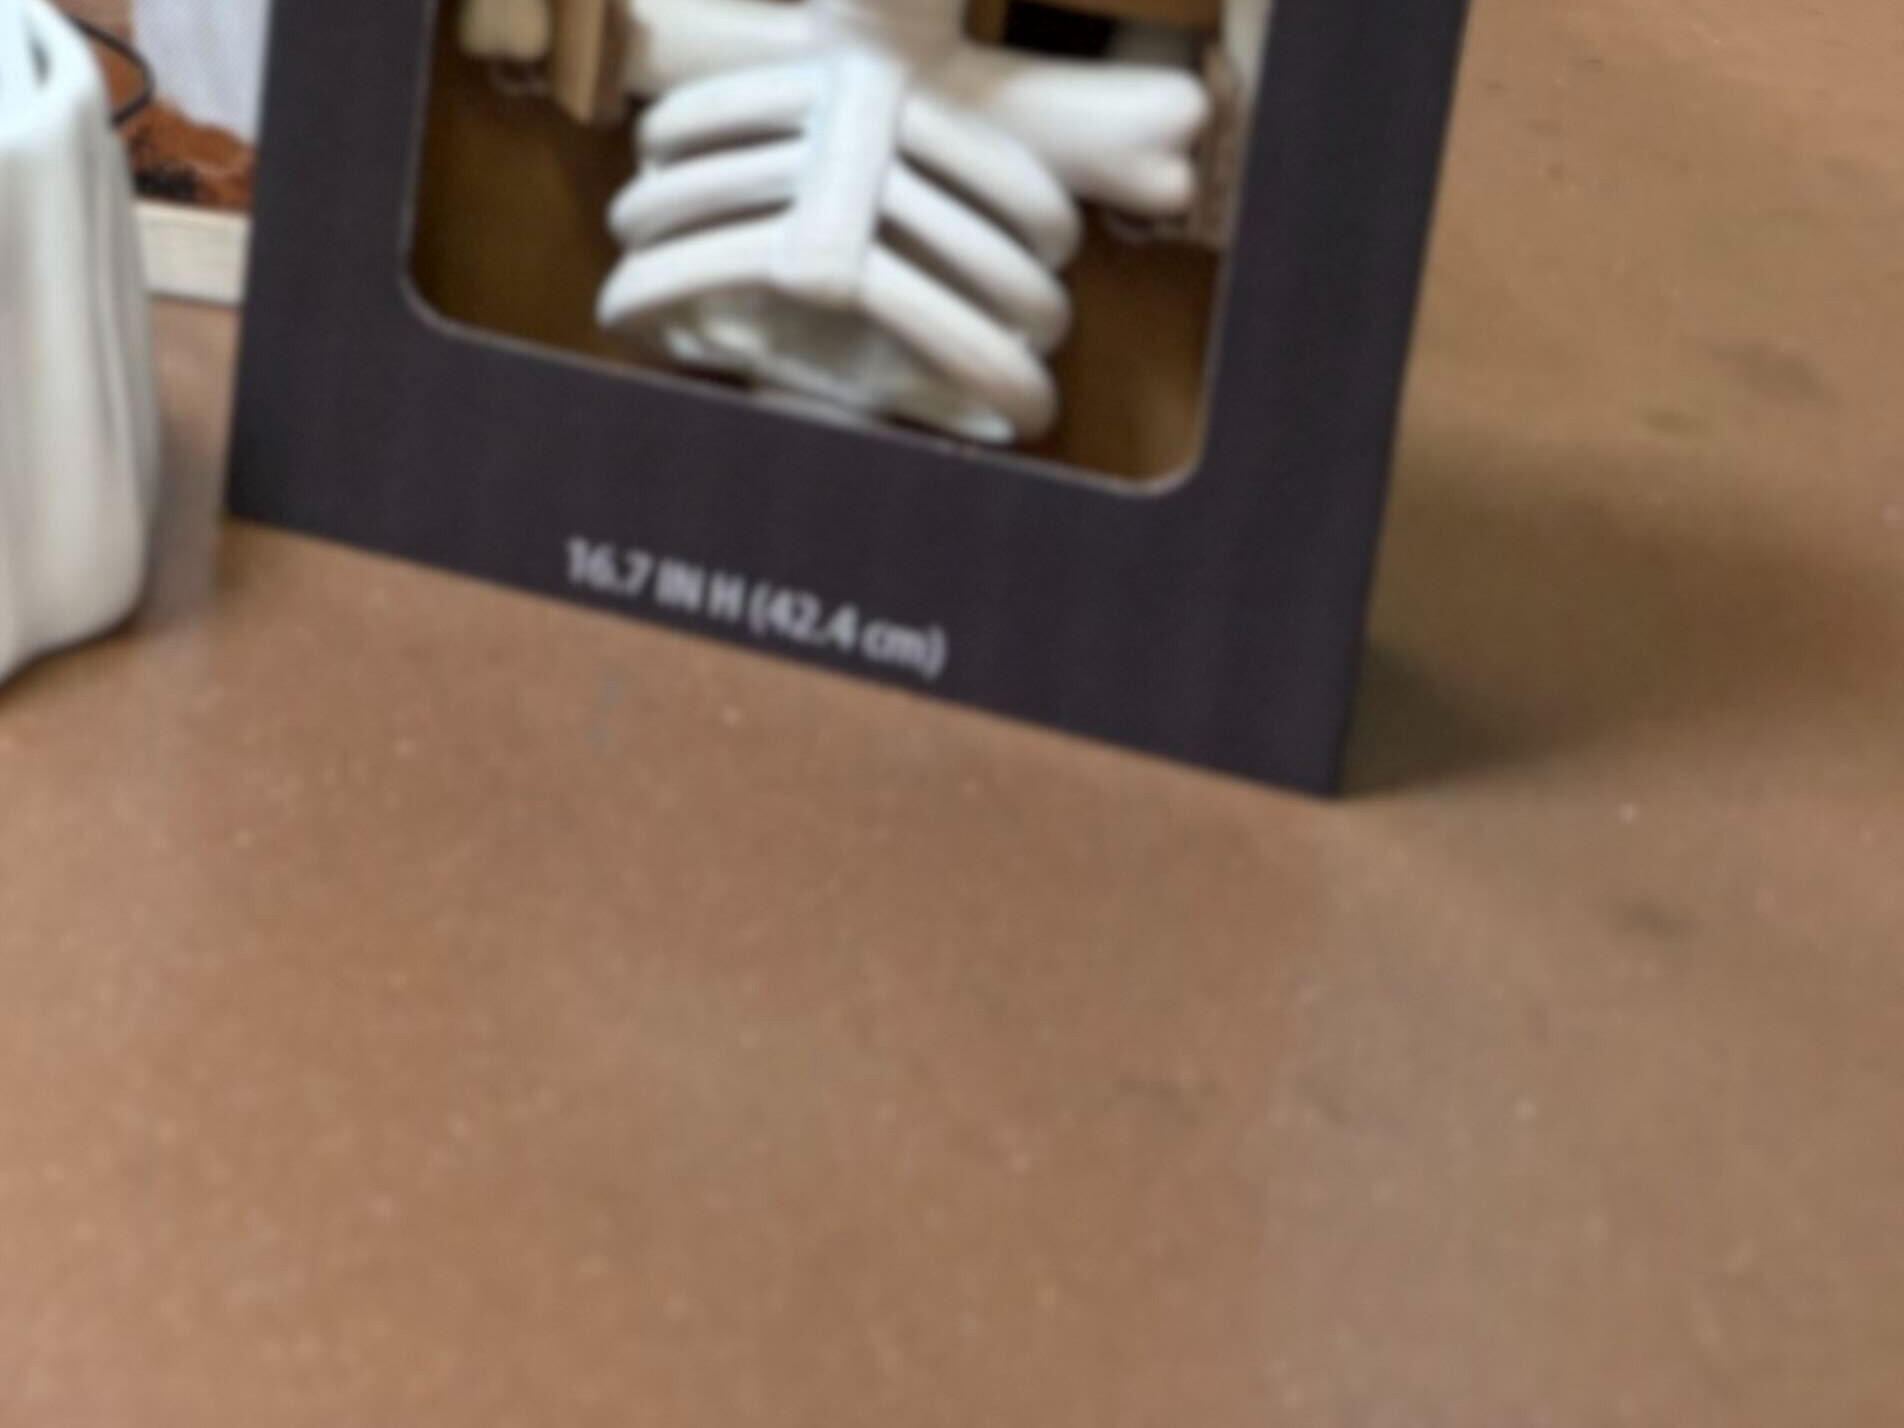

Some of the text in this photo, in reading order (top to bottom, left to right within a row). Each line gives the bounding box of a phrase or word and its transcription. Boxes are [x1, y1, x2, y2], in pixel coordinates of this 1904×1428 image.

[566, 537, 948, 681] 16.7 IN H (42.4 cm)
